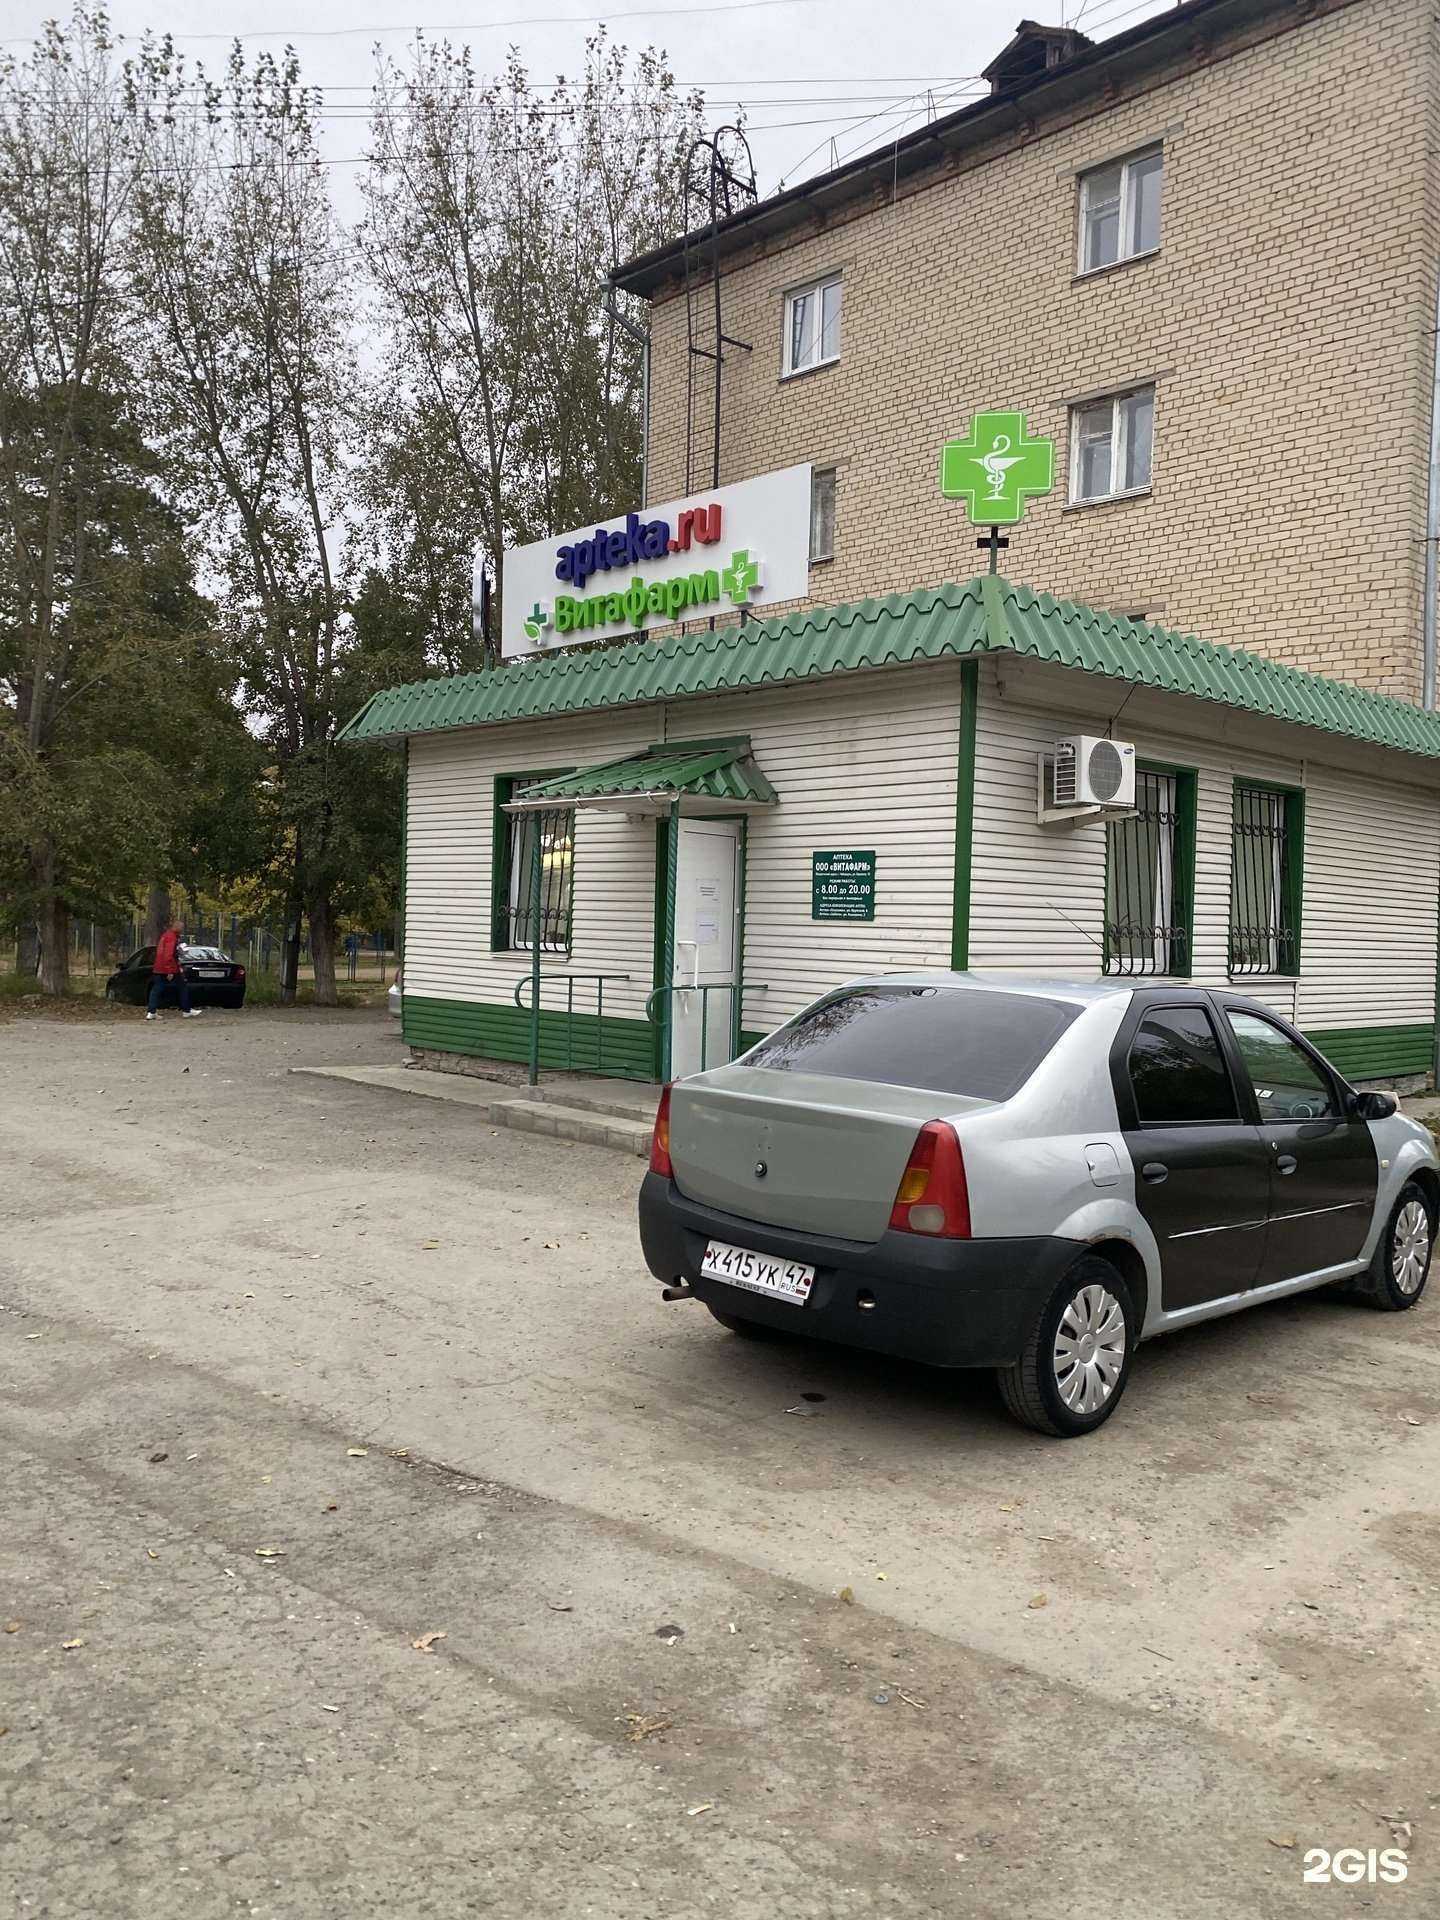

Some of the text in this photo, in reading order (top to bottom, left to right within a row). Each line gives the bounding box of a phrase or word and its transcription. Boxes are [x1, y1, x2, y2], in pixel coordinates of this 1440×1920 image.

[555, 503, 722, 588] apteka.ru
[555, 569, 720, 633] Витафарм
[815, 862, 829, 871] ООО
[821, 884, 838, 894] 8.00
[848, 884, 871, 895] 20.00
[785, 1264, 806, 1285] 47
[780, 1281, 796, 1293] RUS
